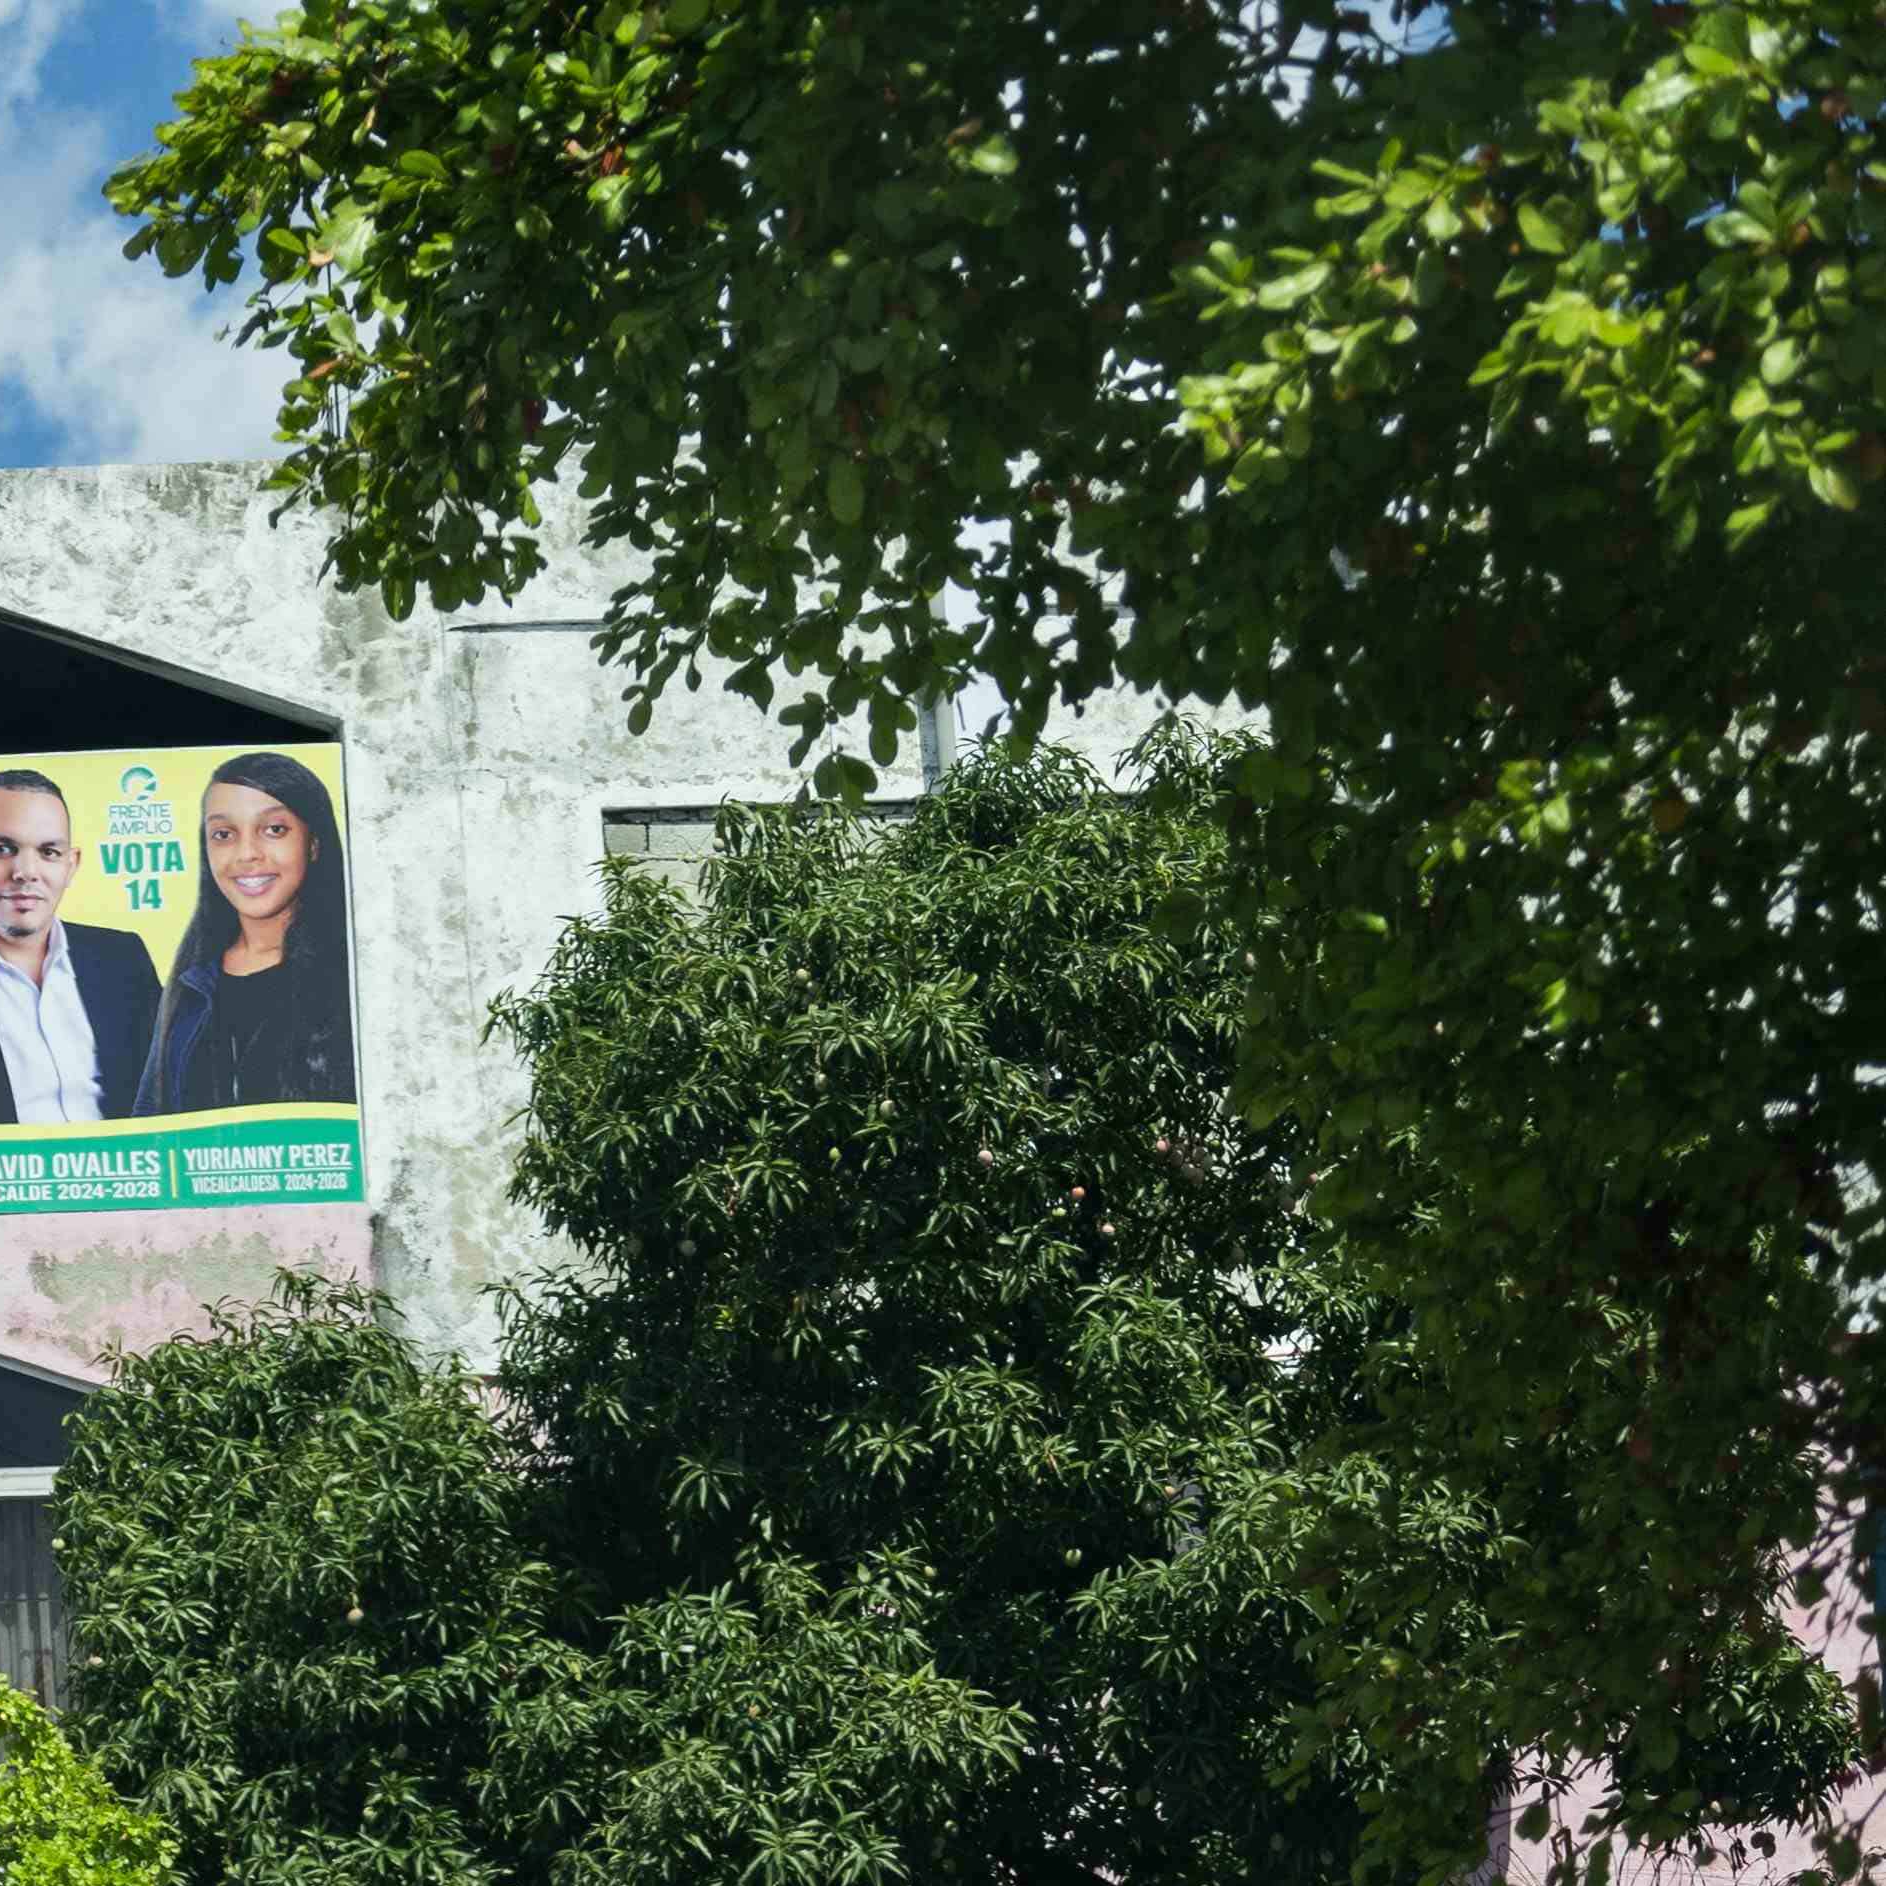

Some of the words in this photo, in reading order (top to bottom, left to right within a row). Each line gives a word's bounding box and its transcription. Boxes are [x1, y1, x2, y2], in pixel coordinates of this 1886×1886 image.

[109, 803, 171, 818] FRENTE
[109, 820, 172, 834] AMPLIO
[100, 841, 185, 874] VOTA
[125, 879, 162, 910] 14
[52, 1151, 161, 1178] OVALLES
[183, 1145, 283, 1170] YURIANNY
[288, 1143, 352, 1167] PEREZ
[57, 1181, 160, 1199] 2024-2028
[191, 1174, 279, 1194] VICEALCALDESA
[285, 1172, 348, 1191] 2024-2028
